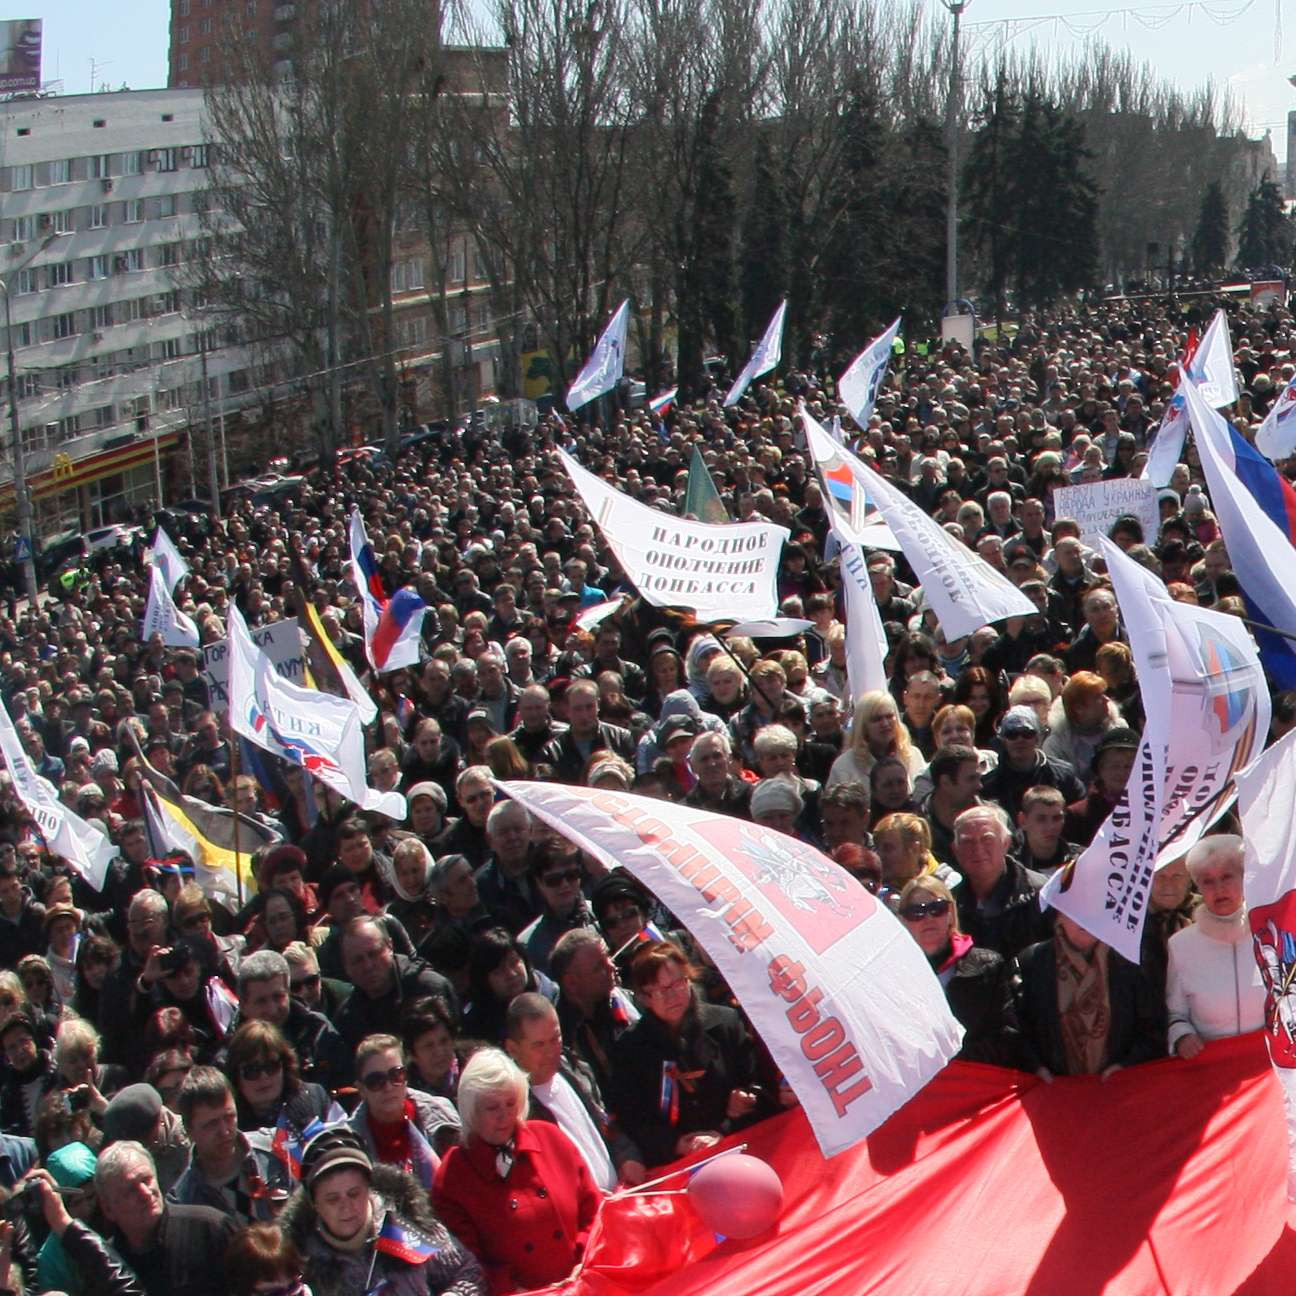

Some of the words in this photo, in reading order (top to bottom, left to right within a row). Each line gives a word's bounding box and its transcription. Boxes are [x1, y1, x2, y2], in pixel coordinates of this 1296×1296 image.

[652, 526, 768, 555] НАРОДНОЕ
[646, 549, 766, 575] ОПОЛЧЕНИЕ
[638, 572, 755, 594] ДОНБАССА
